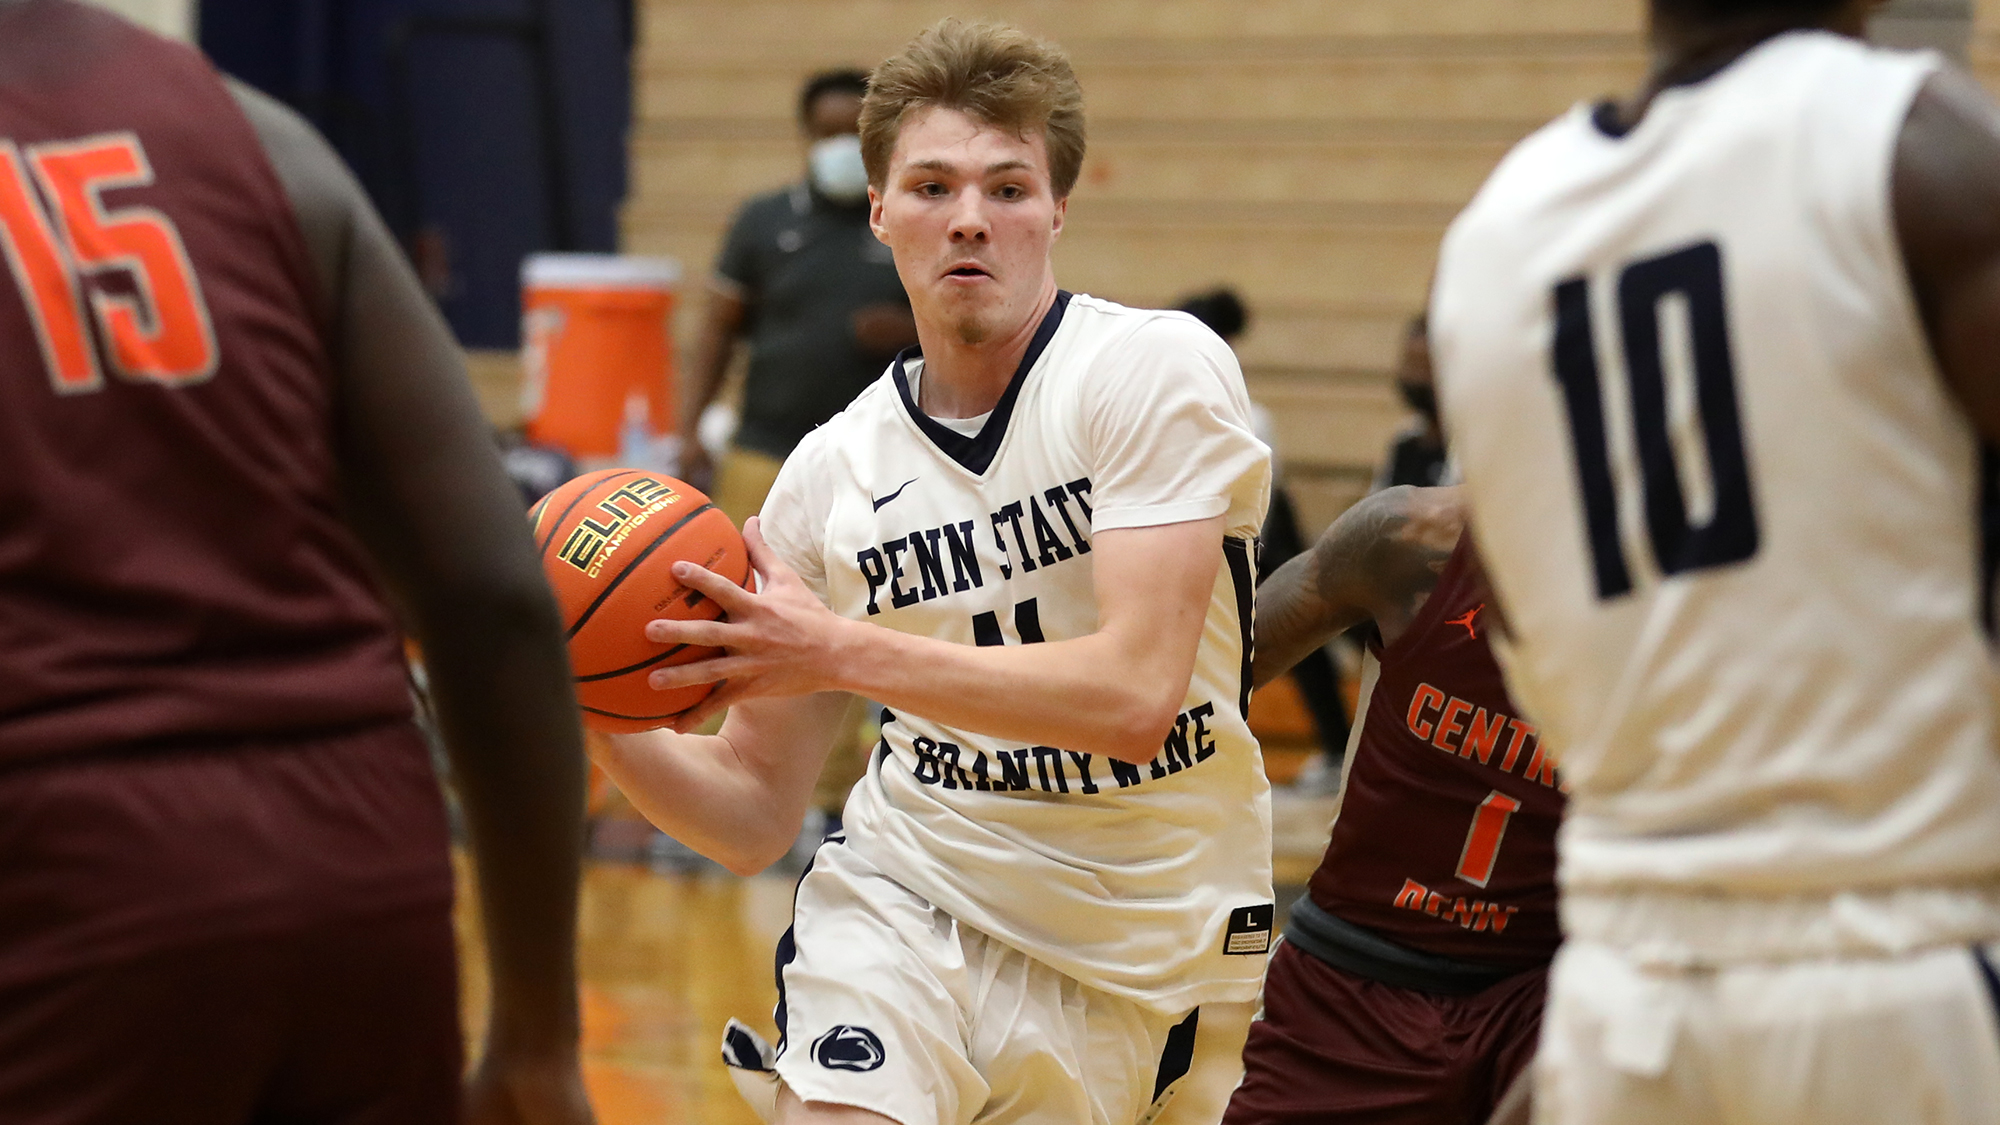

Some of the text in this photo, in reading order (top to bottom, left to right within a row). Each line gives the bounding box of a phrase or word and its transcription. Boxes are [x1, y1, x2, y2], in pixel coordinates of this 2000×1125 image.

[0, 131, 220, 397] 15
[1551, 239, 1763, 601] 10
[556, 477, 675, 573] ELITE
[587, 494, 681, 579] CHAMPIONSHIP
[856, 520, 983, 616] PENN
[1406, 683, 1570, 794] CENTR
[1454, 790, 1521, 889] 1
[1246, 912, 1258, 928] L
